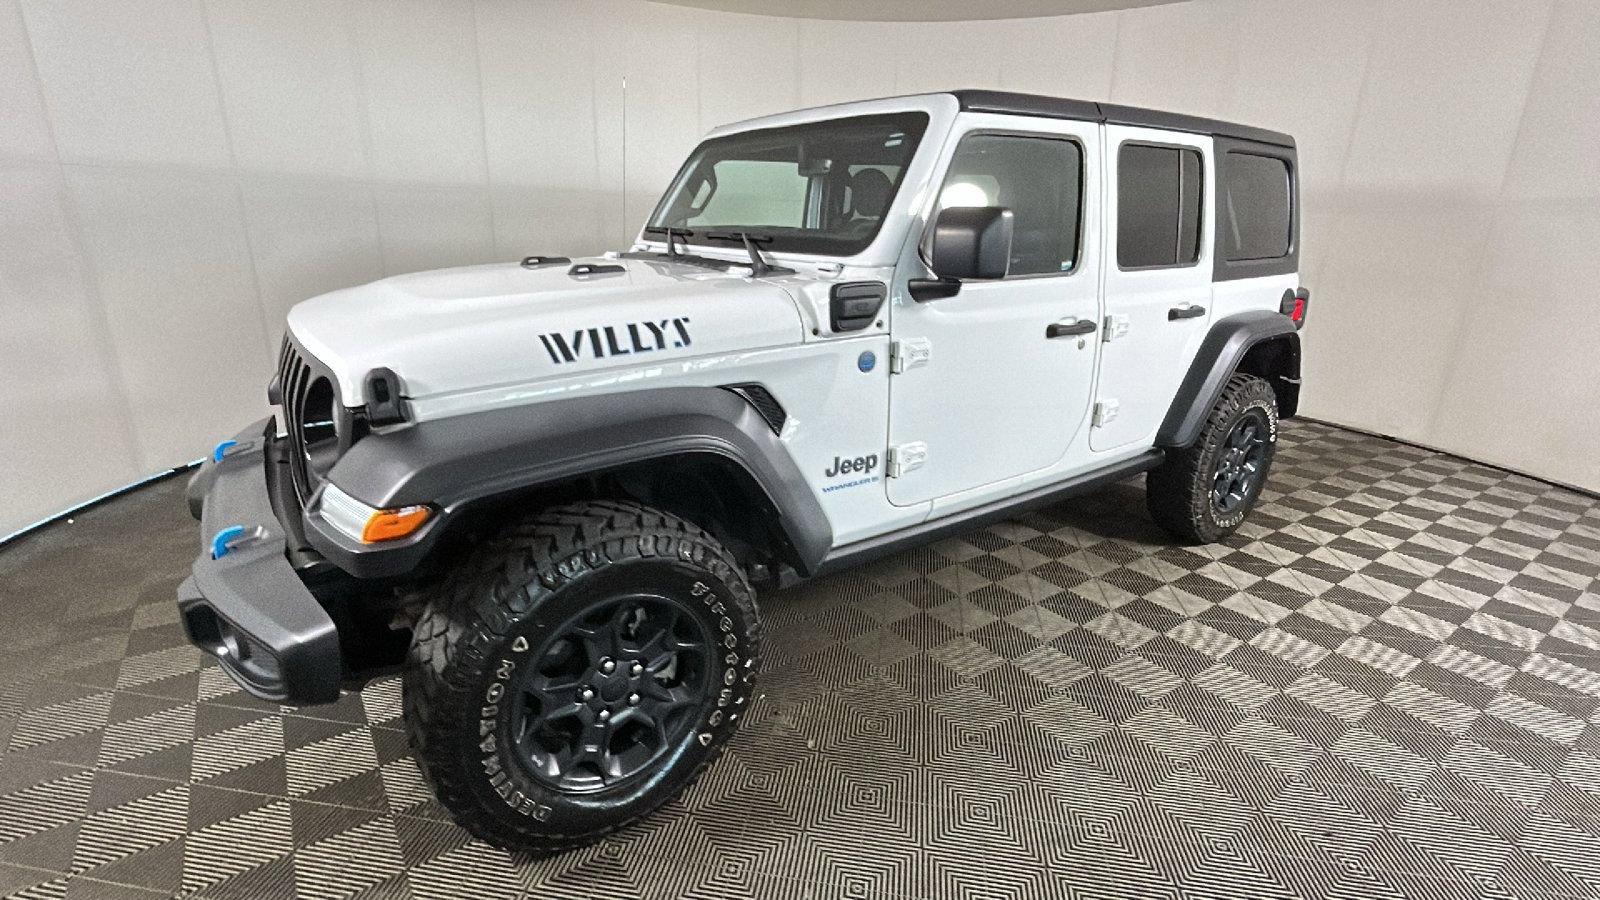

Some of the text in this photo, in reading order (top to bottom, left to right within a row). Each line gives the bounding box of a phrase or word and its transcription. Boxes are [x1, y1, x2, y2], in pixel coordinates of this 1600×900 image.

[538, 317, 692, 364] WILLYS
[825, 454, 878, 477] Jeep
[478, 659, 553, 822] DESTINATION
